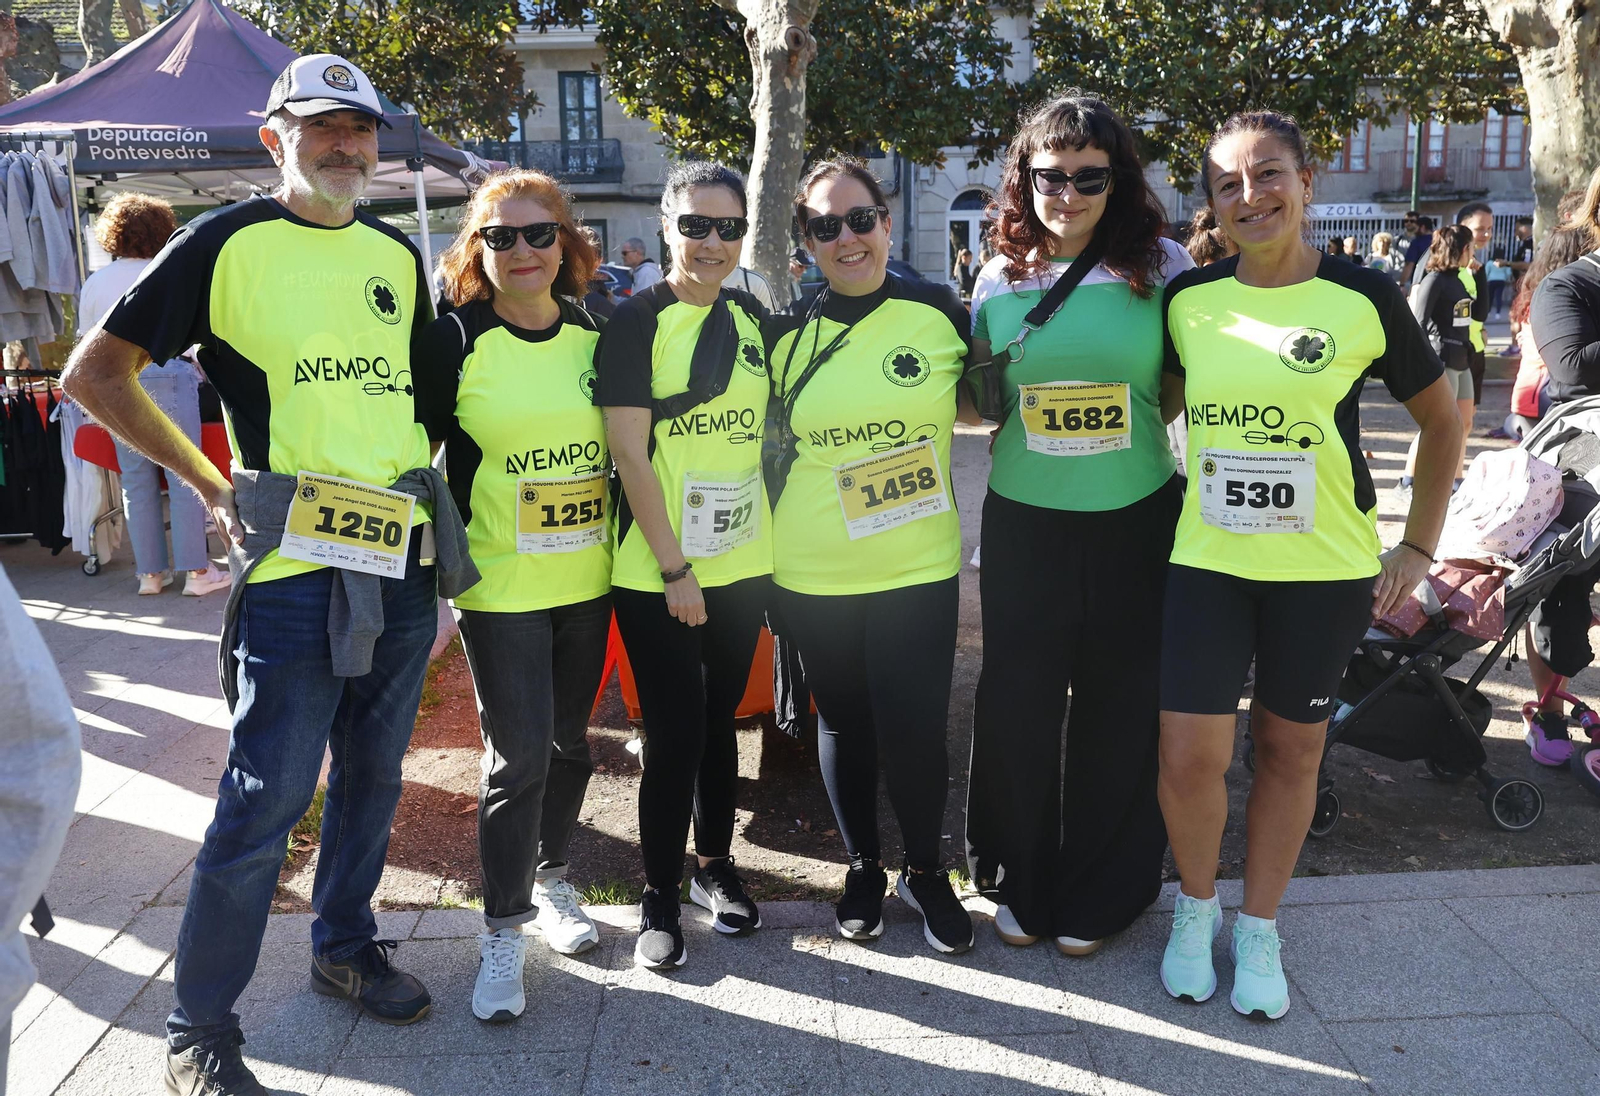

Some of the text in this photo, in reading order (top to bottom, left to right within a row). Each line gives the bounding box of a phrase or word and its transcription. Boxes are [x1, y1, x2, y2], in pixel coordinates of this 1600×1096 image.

[87, 127, 208, 146] Deputación
[89, 145, 211, 160] Pontevedra
[1326, 206, 1373, 215] ZOILA
[294, 356, 390, 386] AVEMPO
[668, 408, 755, 437] AVEMPO
[1042, 405, 1124, 431] 1682
[1191, 404, 1284, 429] AVEMPO
[808, 420, 906, 447] AVEMPO
[506, 440, 600, 475] AVEMPO
[879, 453, 905, 463] ESCLEROSE
[356, 486, 385, 497] ESCLEROSE
[860, 467, 936, 508] 1458
[1226, 480, 1295, 509] 530
[541, 498, 603, 527] 1251
[714, 500, 753, 533] 527
[314, 506, 402, 547] 1250
[1310, 697, 1329, 706] FILA
